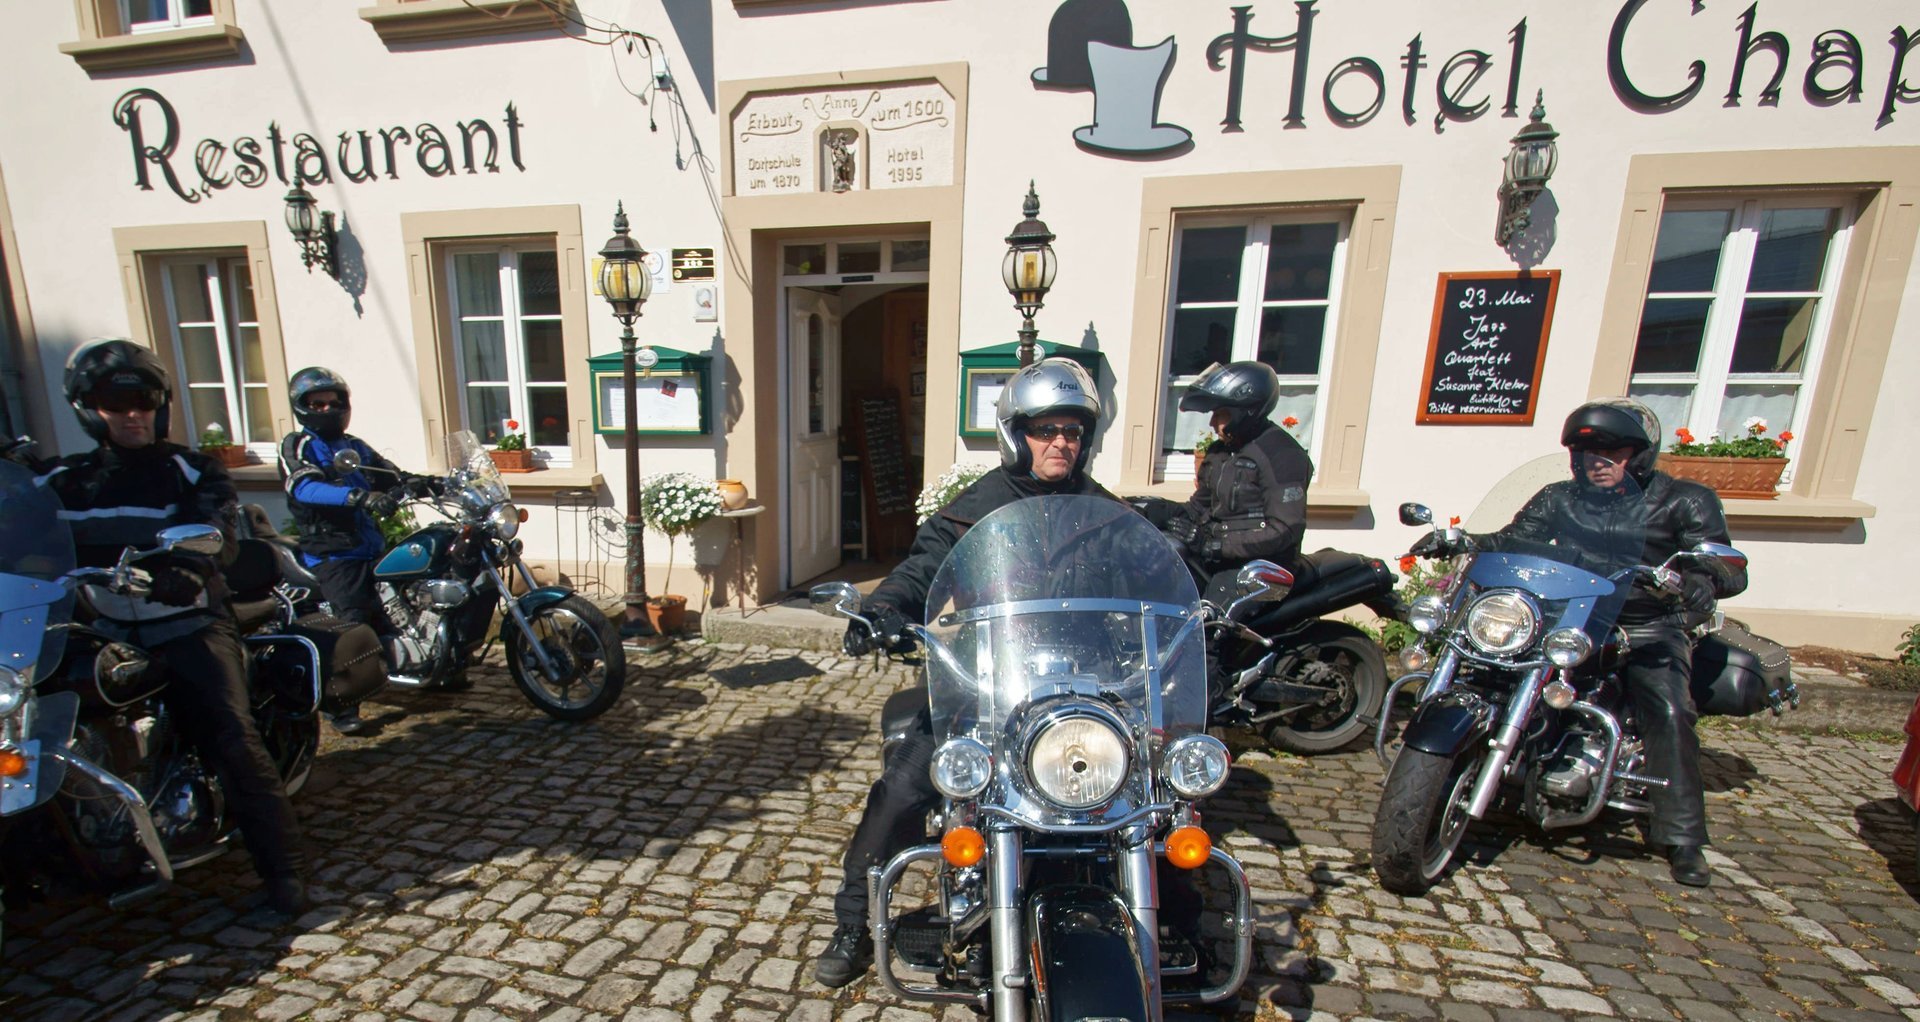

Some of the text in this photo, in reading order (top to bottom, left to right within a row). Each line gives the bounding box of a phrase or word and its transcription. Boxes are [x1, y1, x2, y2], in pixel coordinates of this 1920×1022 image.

[1206, 0, 1527, 134] Hotel
[748, 94, 944, 131] Erbaut Anno um 1600
[113, 87, 526, 203] Restaurant
[887, 146, 924, 163] Hotel
[750, 174, 801, 189] um 1870
[888, 167, 923, 183] 1995
[1459, 287, 1534, 309] 23. Mai
[1463, 314, 1507, 341] Jazz
[1461, 335, 1500, 350] Art
[1444, 350, 1511, 366] Quartett
[1467, 364, 1501, 380] feat.
[1052, 381, 1078, 391] Arai
[1435, 376, 1482, 392] Susanne
[1428, 402, 1455, 414] Bitte
